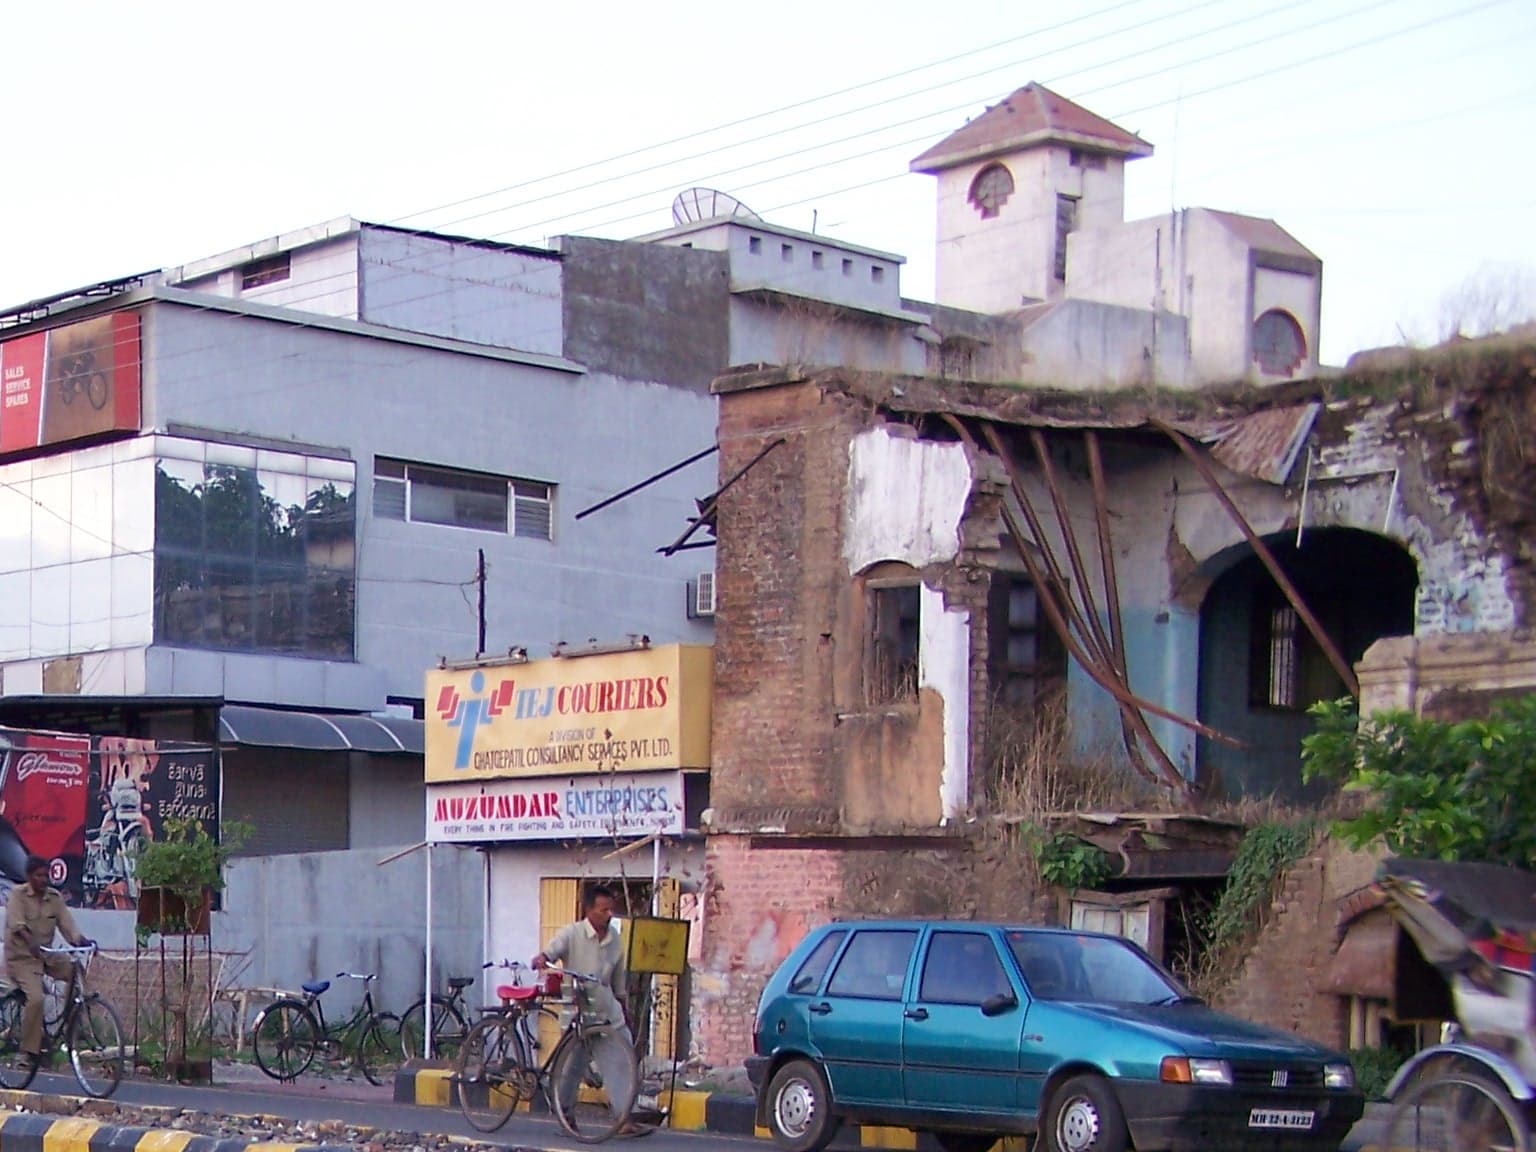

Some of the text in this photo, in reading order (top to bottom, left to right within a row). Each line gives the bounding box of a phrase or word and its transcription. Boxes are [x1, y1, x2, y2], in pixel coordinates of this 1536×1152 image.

[557, 676, 669, 715] COURIERS
[526, 743, 584, 768] CONSULTANCY
[588, 740, 628, 762] SERVICES
[631, 738, 650, 759] PVT.
[652, 737, 673, 757] LTD.
[434, 792, 561, 822] MUZUMDAR
[54, 864, 62, 879] 3
